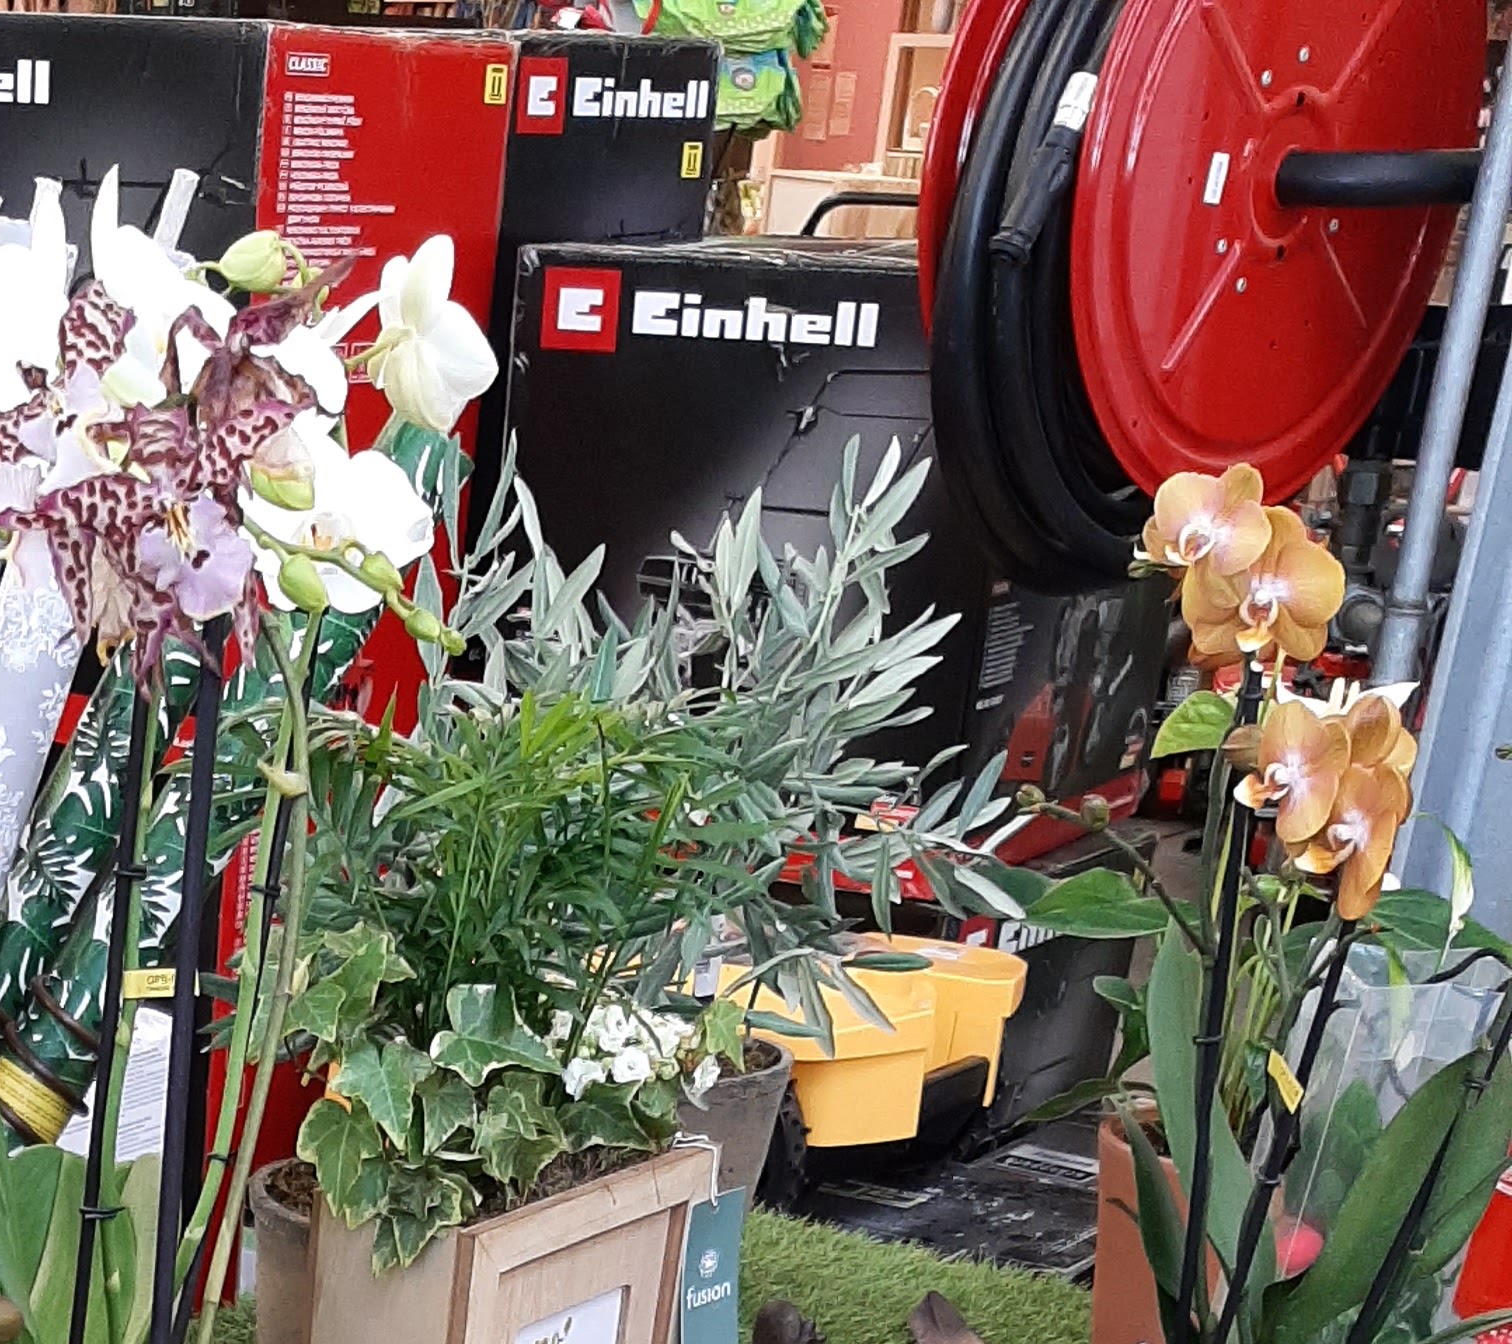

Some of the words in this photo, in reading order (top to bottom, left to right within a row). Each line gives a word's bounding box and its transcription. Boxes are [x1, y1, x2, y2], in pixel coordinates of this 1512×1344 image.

[288, 55, 328, 72] CLASSIC
[572, 76, 710, 119] Einhell
[631, 290, 880, 349] Einhell
[686, 1280, 732, 1310] fusion
